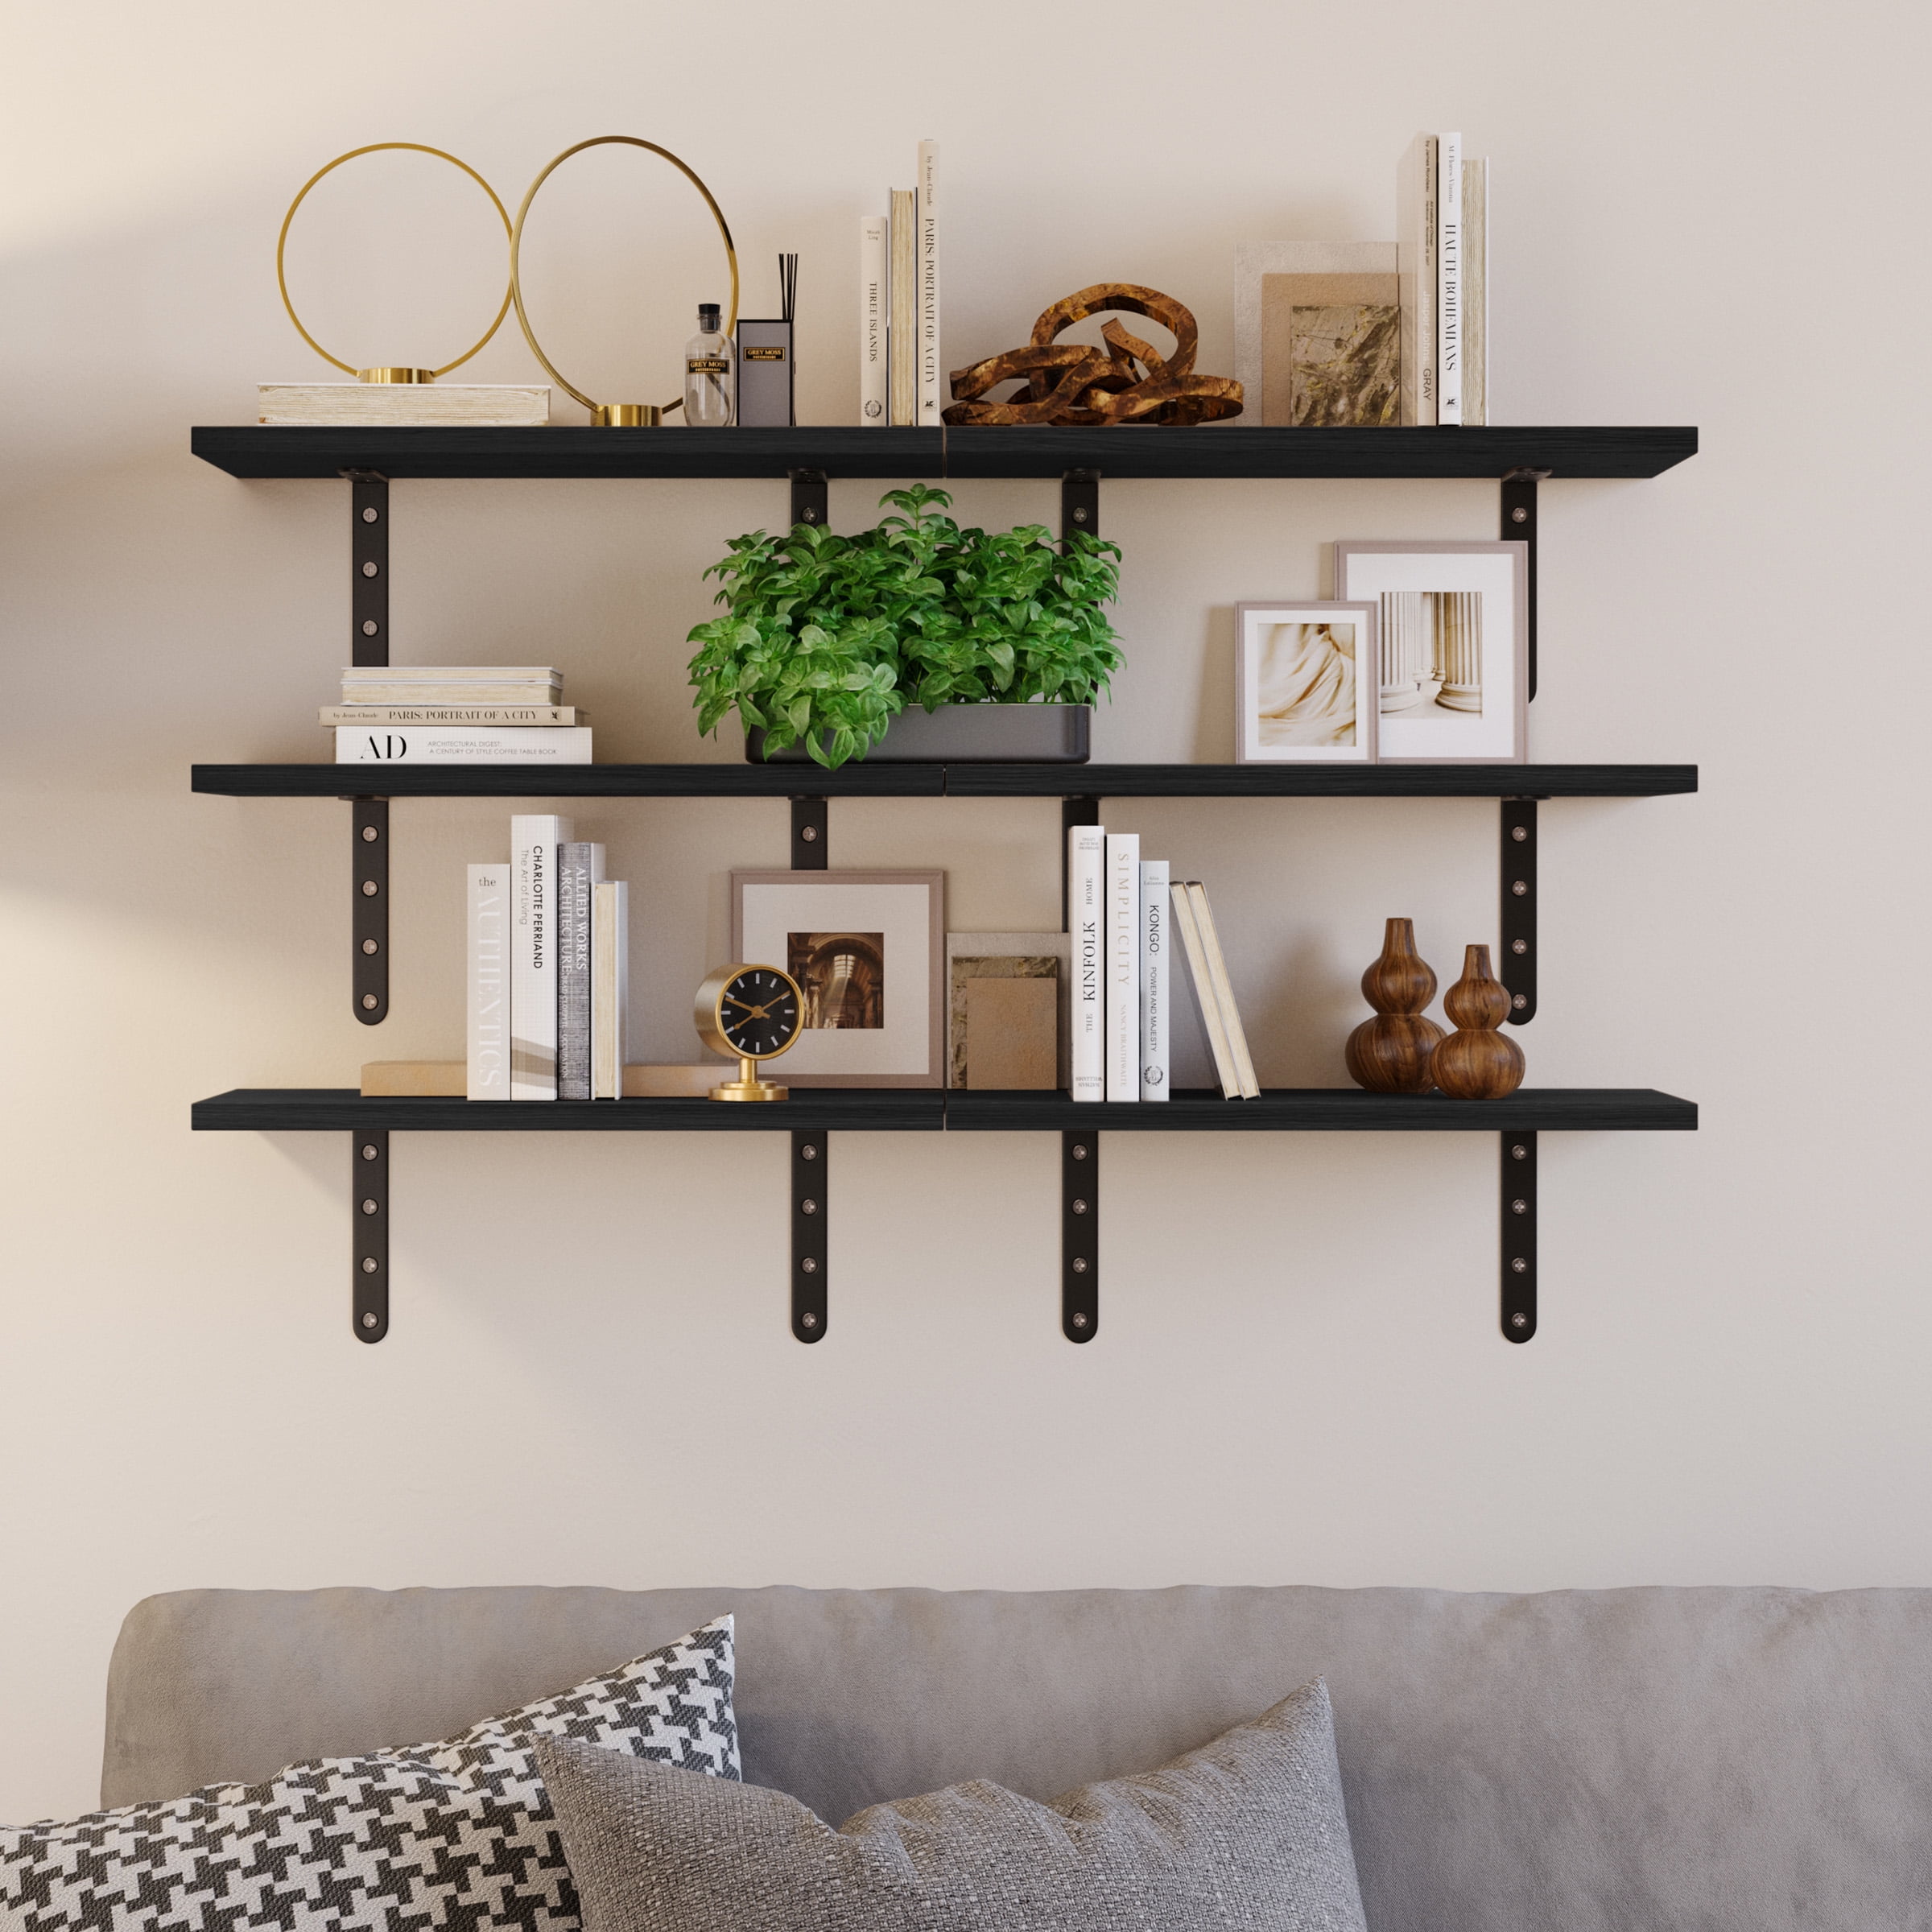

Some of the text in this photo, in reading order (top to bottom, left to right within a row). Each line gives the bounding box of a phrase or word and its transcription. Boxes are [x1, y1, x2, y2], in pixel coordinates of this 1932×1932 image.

[869, 282, 877, 362] THREE ISLANDS
[925, 219, 935, 385] PARIS: PORTRAIT OF A CITY
[1445, 225, 1456, 370] HAUTE BOHEMIANS
[1422, 291, 1431, 401] Jasper Johns: GRAY
[360, 735, 407, 759] AD
[389, 711, 423, 720] PARIS:
[426, 711, 483, 720] PORTRAIT
[485, 711, 499, 720] OF
[502, 711, 510, 720] A
[512, 711, 538, 720] CITY
[478, 877, 497, 887] the
[519, 849, 530, 925] The Art of Living
[533, 846, 543, 969] CHARLOTTE PERRIAND
[576, 867, 587, 970] ALLIED WORKS
[1117, 853, 1129, 986] SIMPLICITY
[1084, 922, 1096, 1001] KINFOLK
[1149, 905, 1159, 956] KONGO:
[477, 888, 502, 1086] AUTHENTICS
